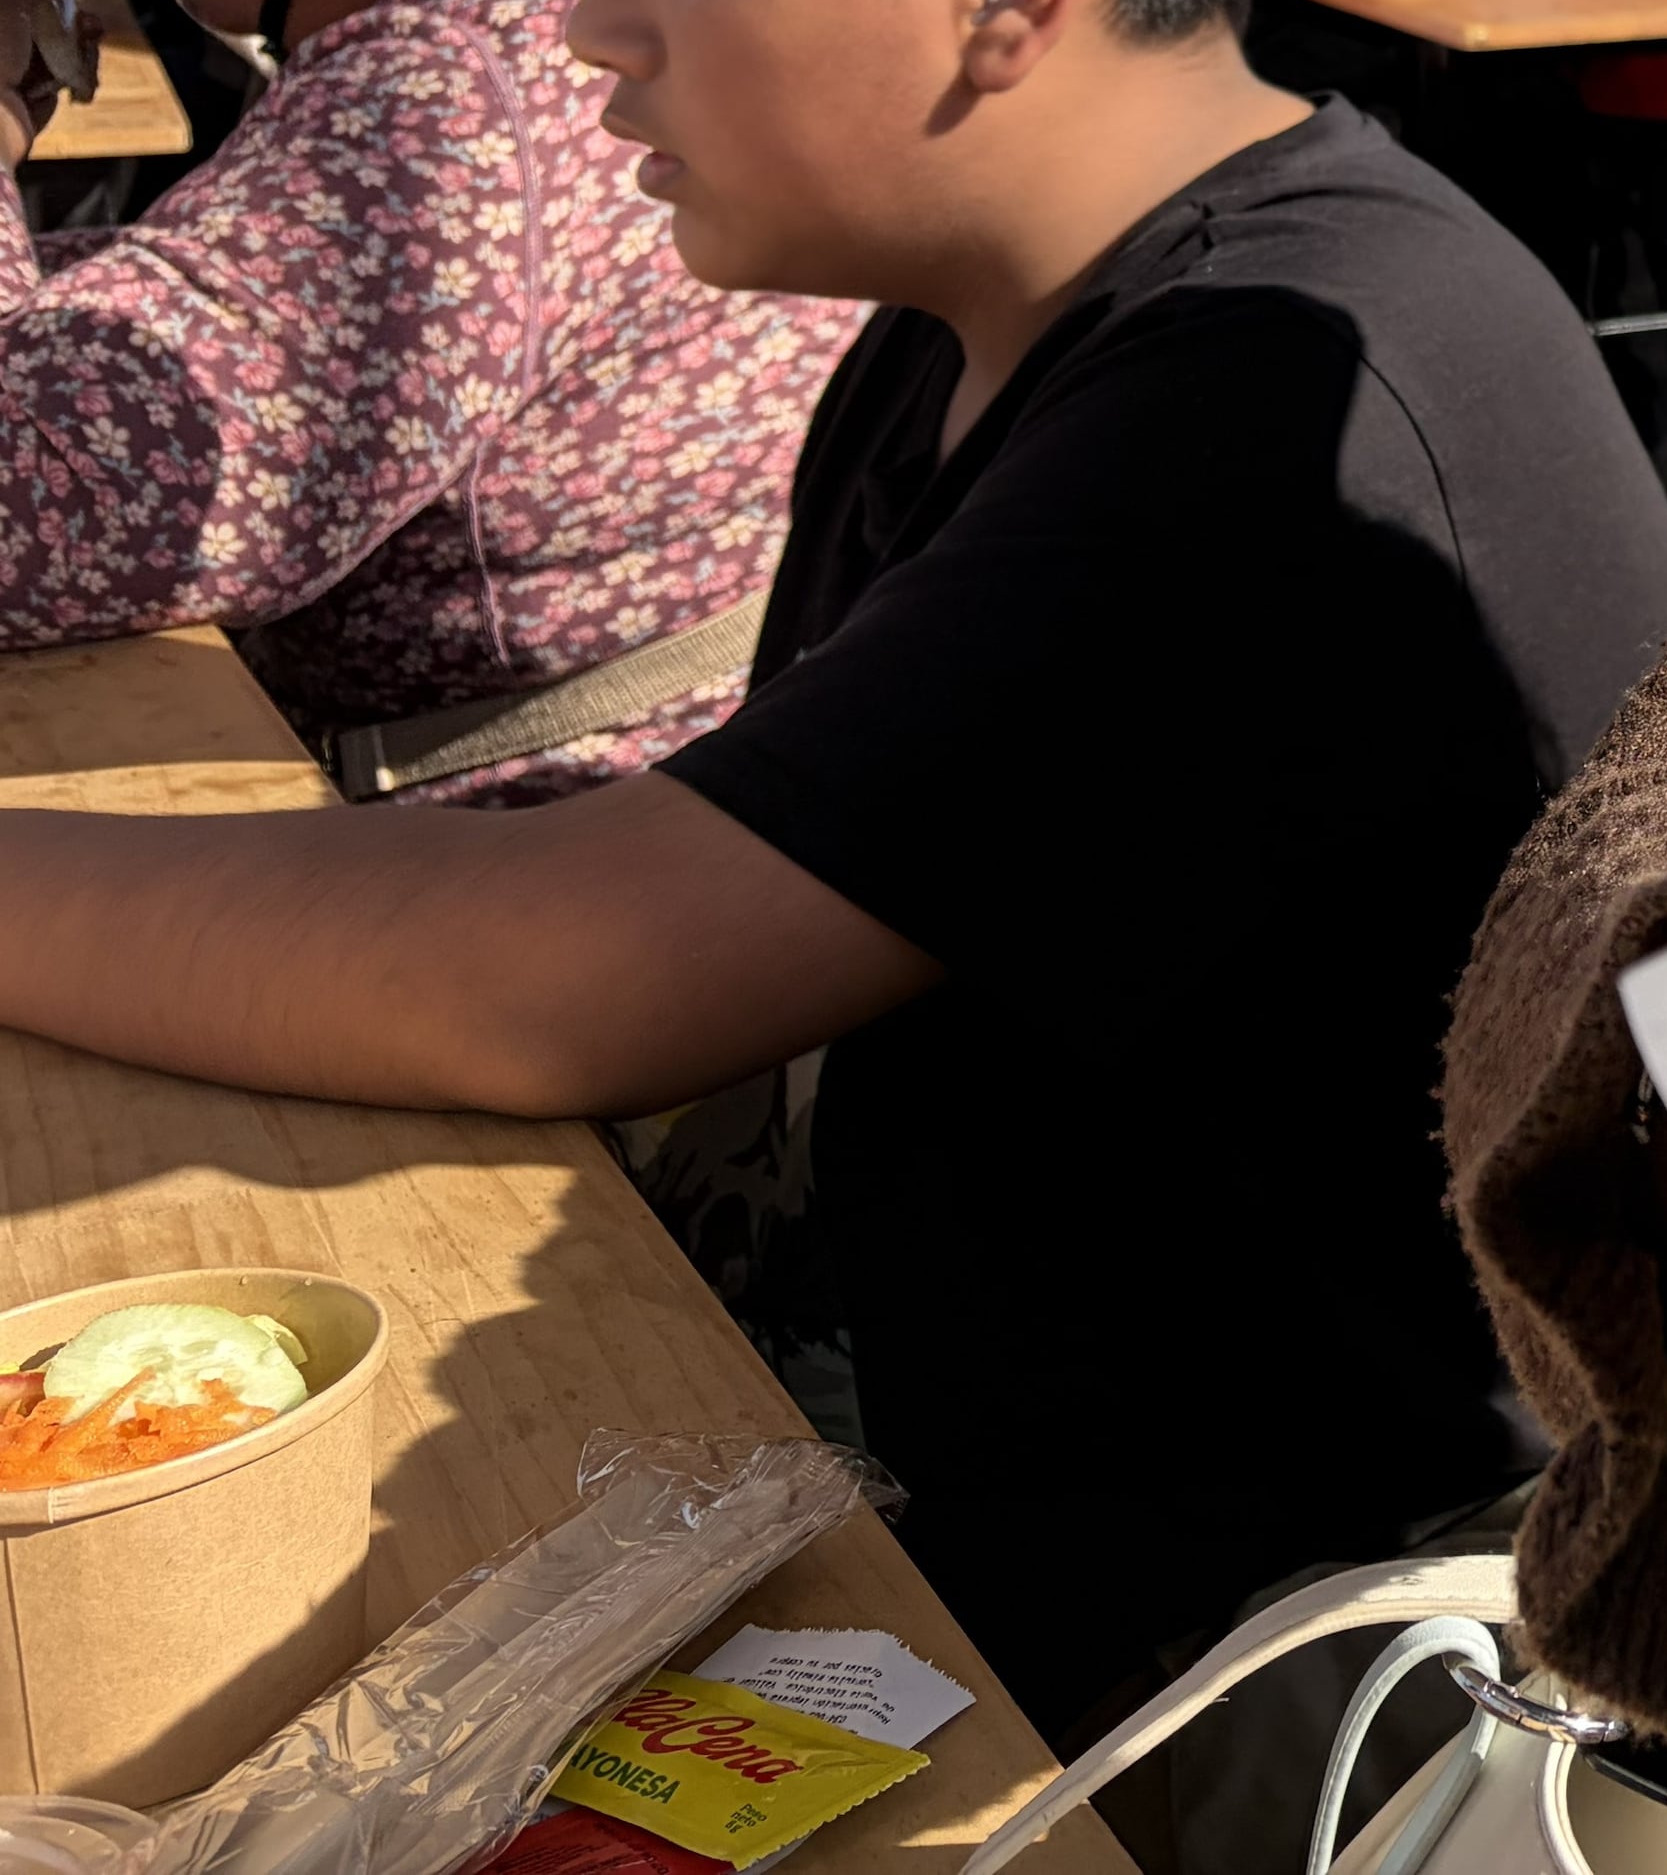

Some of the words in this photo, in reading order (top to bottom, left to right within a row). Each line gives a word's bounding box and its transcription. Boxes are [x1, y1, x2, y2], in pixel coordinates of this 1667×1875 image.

[570, 1743, 681, 1805] AYONESA
[730, 1811, 757, 1828] neto
[739, 1802, 768, 1822] Peso
